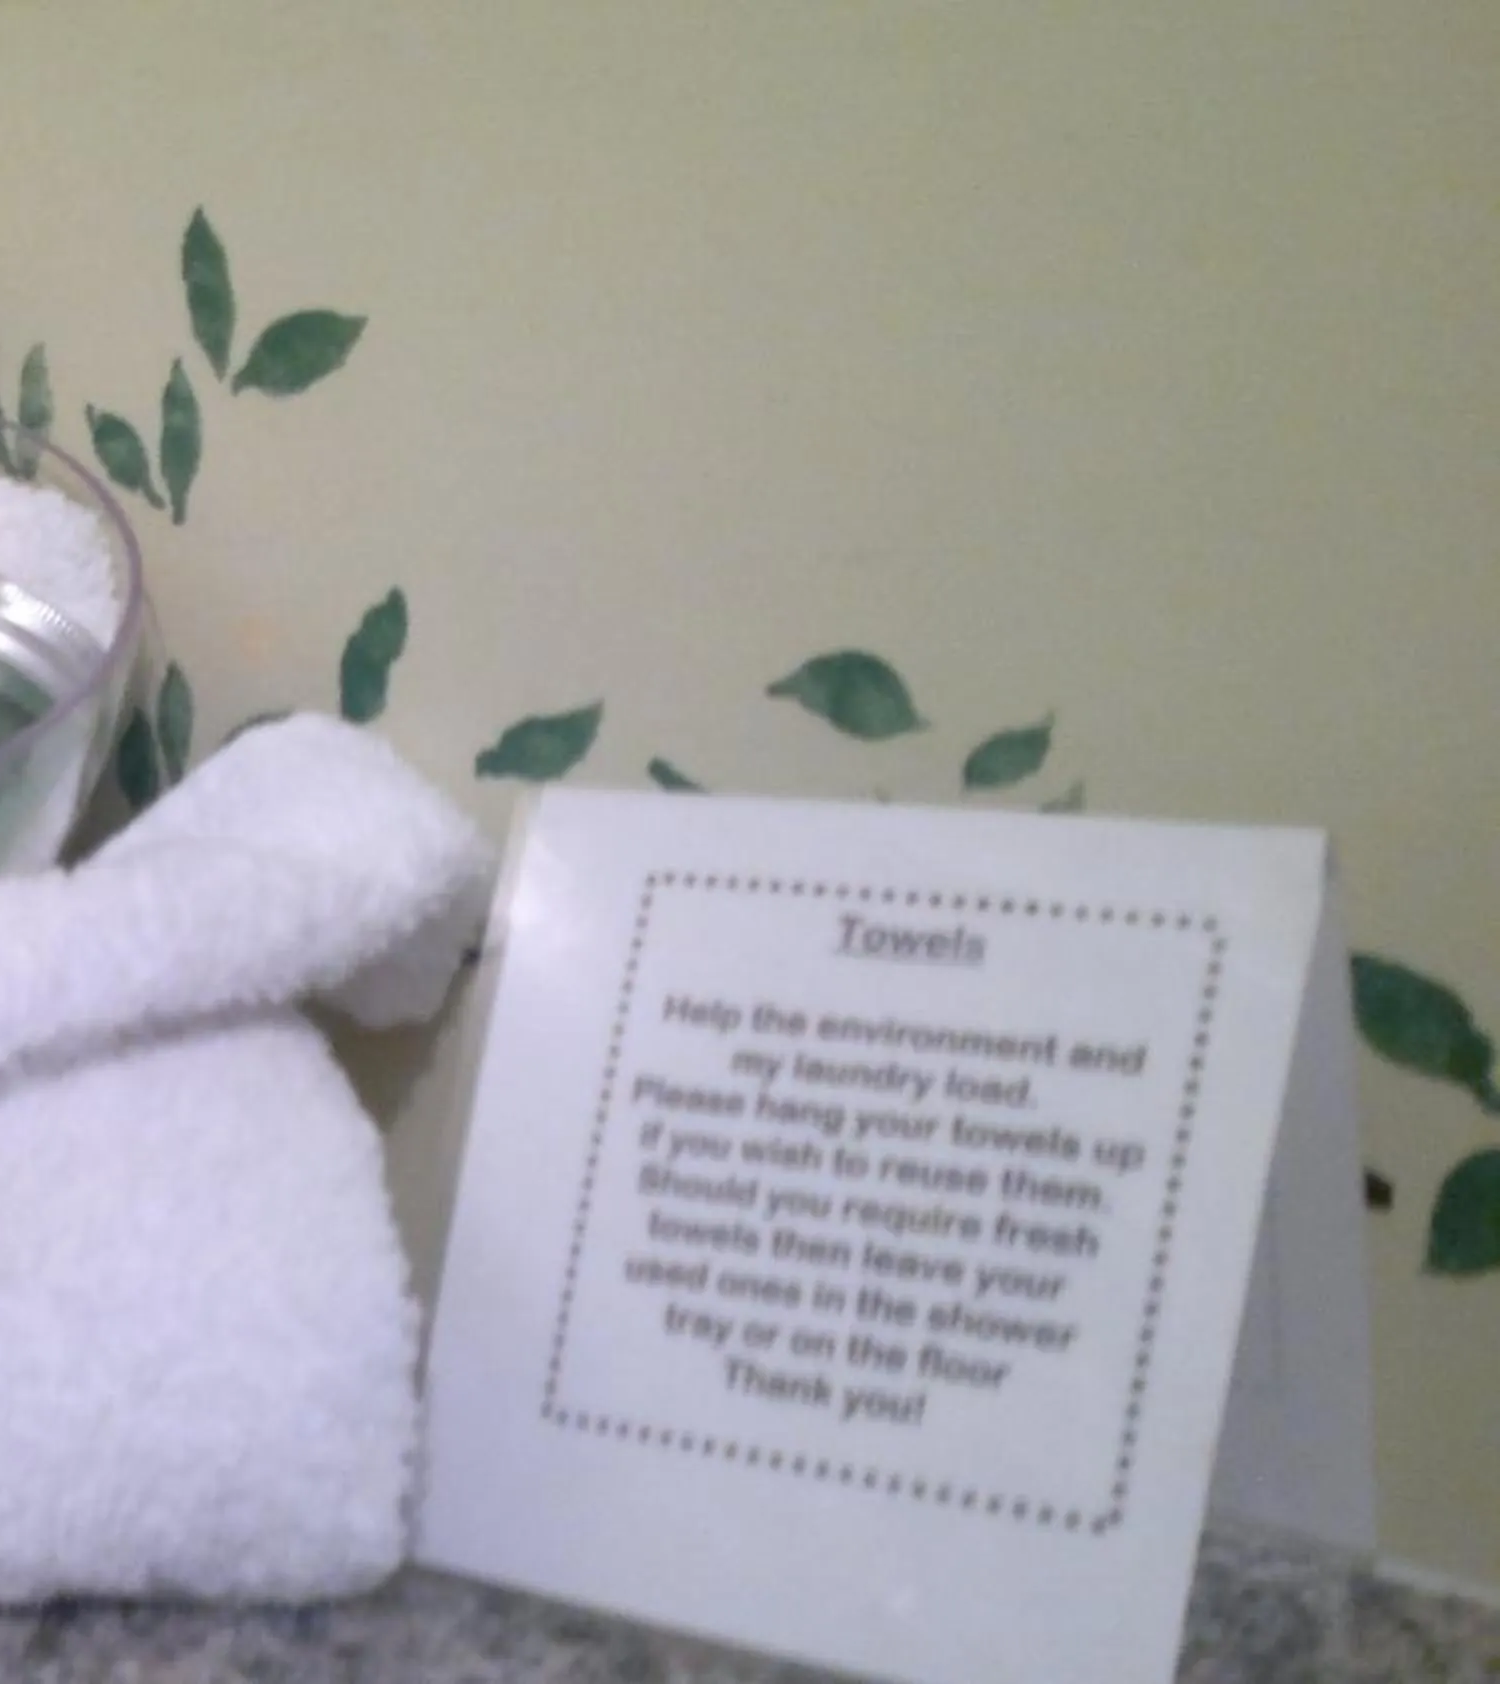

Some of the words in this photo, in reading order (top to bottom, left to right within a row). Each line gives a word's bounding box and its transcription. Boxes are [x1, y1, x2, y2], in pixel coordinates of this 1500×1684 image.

[838, 909, 987, 966] Towels
[662, 993, 743, 1034] Help
[751, 1002, 808, 1038] the
[816, 1016, 1058, 1067] environment
[1068, 1043, 1148, 1078] and
[730, 1048, 784, 1088] my
[794, 1051, 934, 1101] laundry
[632, 1073, 746, 1117] Please
[756, 1089, 846, 1136] hang
[855, 1107, 940, 1141] your
[950, 1114, 1081, 1163] towels
[1093, 1138, 1146, 1175] up
[668, 1130, 734, 1163] you
[740, 1134, 823, 1168] wish
[833, 1146, 870, 1180] to
[878, 1158, 990, 1198] reuse
[636, 1162, 760, 1205] Should
[764, 1185, 834, 1222] you
[840, 1194, 982, 1240] require
[993, 1212, 1102, 1258] fresh
[648, 1208, 760, 1258] towels
[770, 1226, 852, 1271] then
[861, 1242, 966, 1287] leave
[974, 1266, 1067, 1301] your
[624, 1254, 710, 1292] used
[716, 1270, 803, 1306] ones
[812, 1278, 846, 1312] in
[855, 1287, 918, 1328] the
[927, 1298, 1078, 1354] shower
[664, 1302, 734, 1348] tray
[740, 1319, 780, 1350] or
[790, 1328, 837, 1360] on
[846, 1330, 909, 1372] the
[917, 1342, 1012, 1390] floor
[723, 1354, 833, 1407] Thank
[841, 1382, 926, 1425] you!
